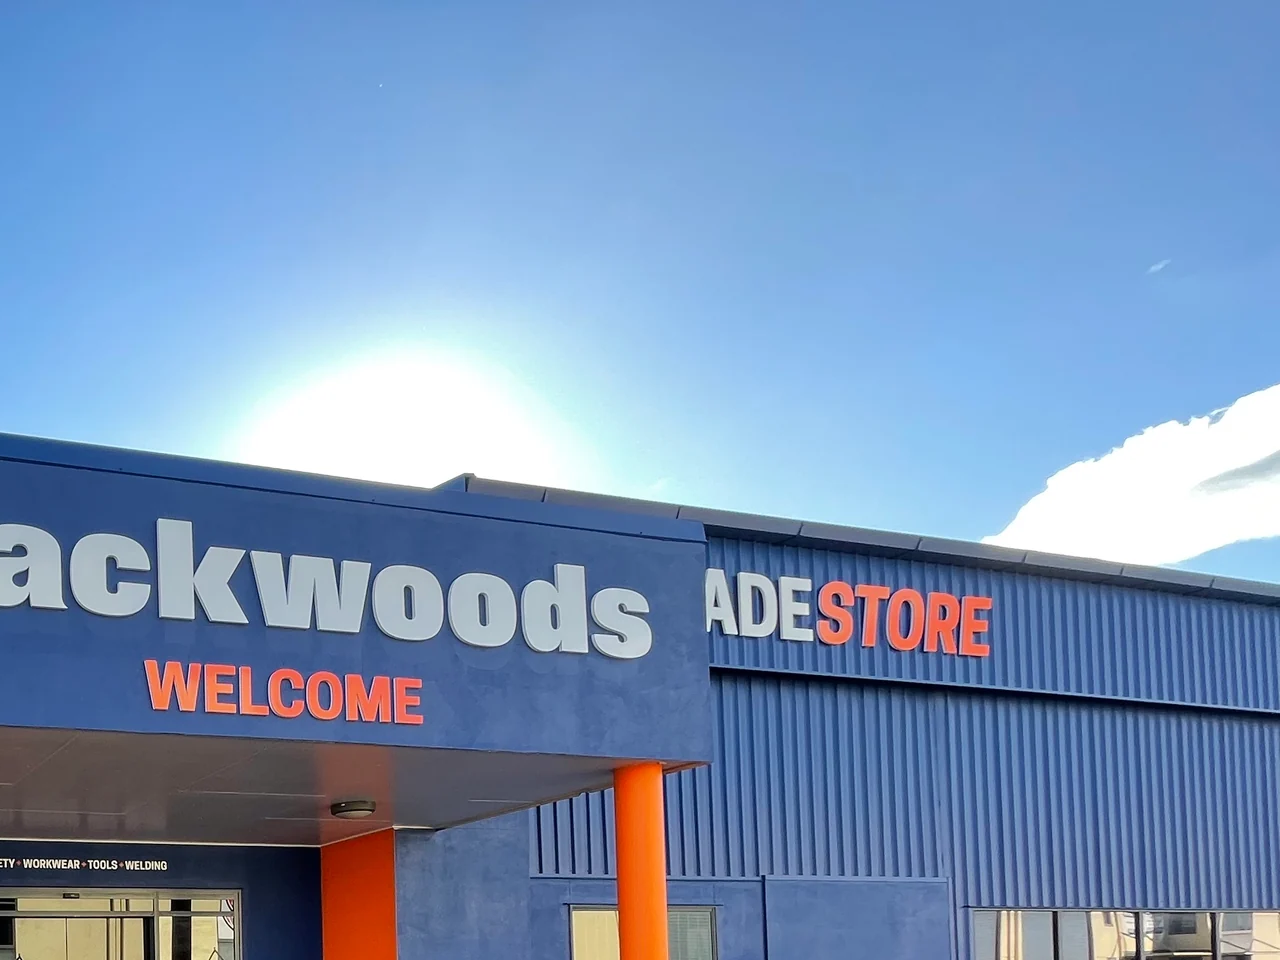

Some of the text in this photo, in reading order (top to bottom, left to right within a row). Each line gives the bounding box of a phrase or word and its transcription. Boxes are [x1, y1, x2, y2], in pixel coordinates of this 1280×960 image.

[144, 659, 424, 725] WELCOME
[22, 858, 81, 870] WORKWEAR
[87, 859, 119, 870] TOOLS
[124, 860, 168, 871] WELDING
